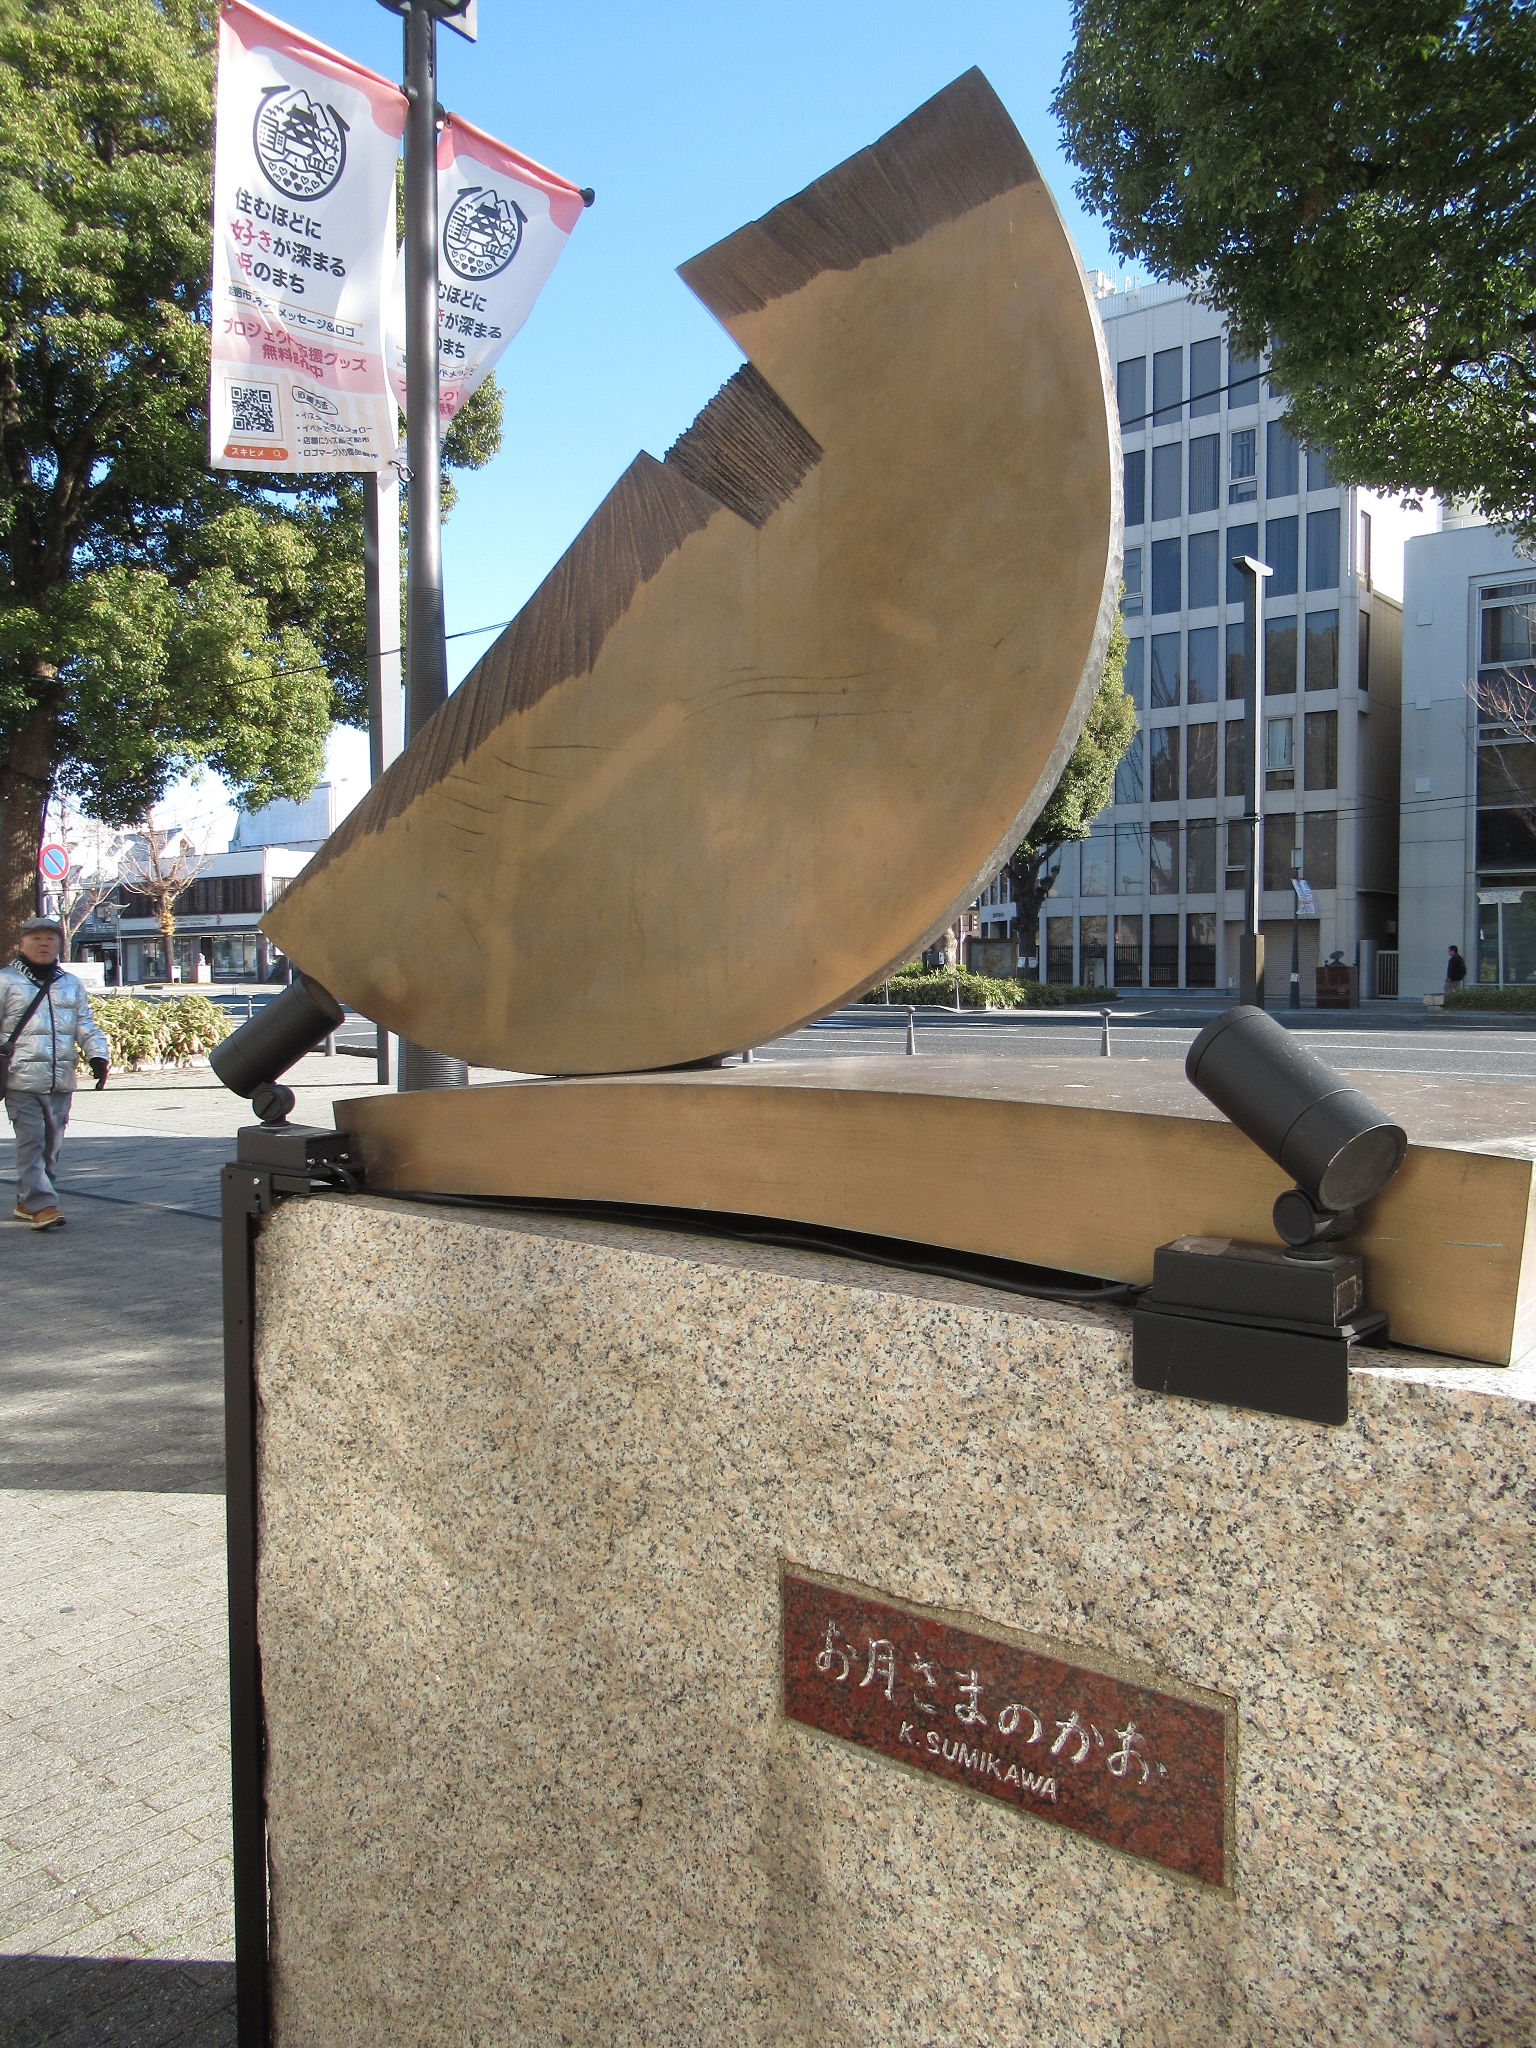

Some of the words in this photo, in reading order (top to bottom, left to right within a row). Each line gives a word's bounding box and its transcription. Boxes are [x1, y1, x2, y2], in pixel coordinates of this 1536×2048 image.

[235, 186, 322, 240] 住むほどに
[230, 218, 346, 278] 好きが深まる
[231, 447, 265, 458] スキヒメ
[815, 1618, 1171, 1786] お月さまのかお
